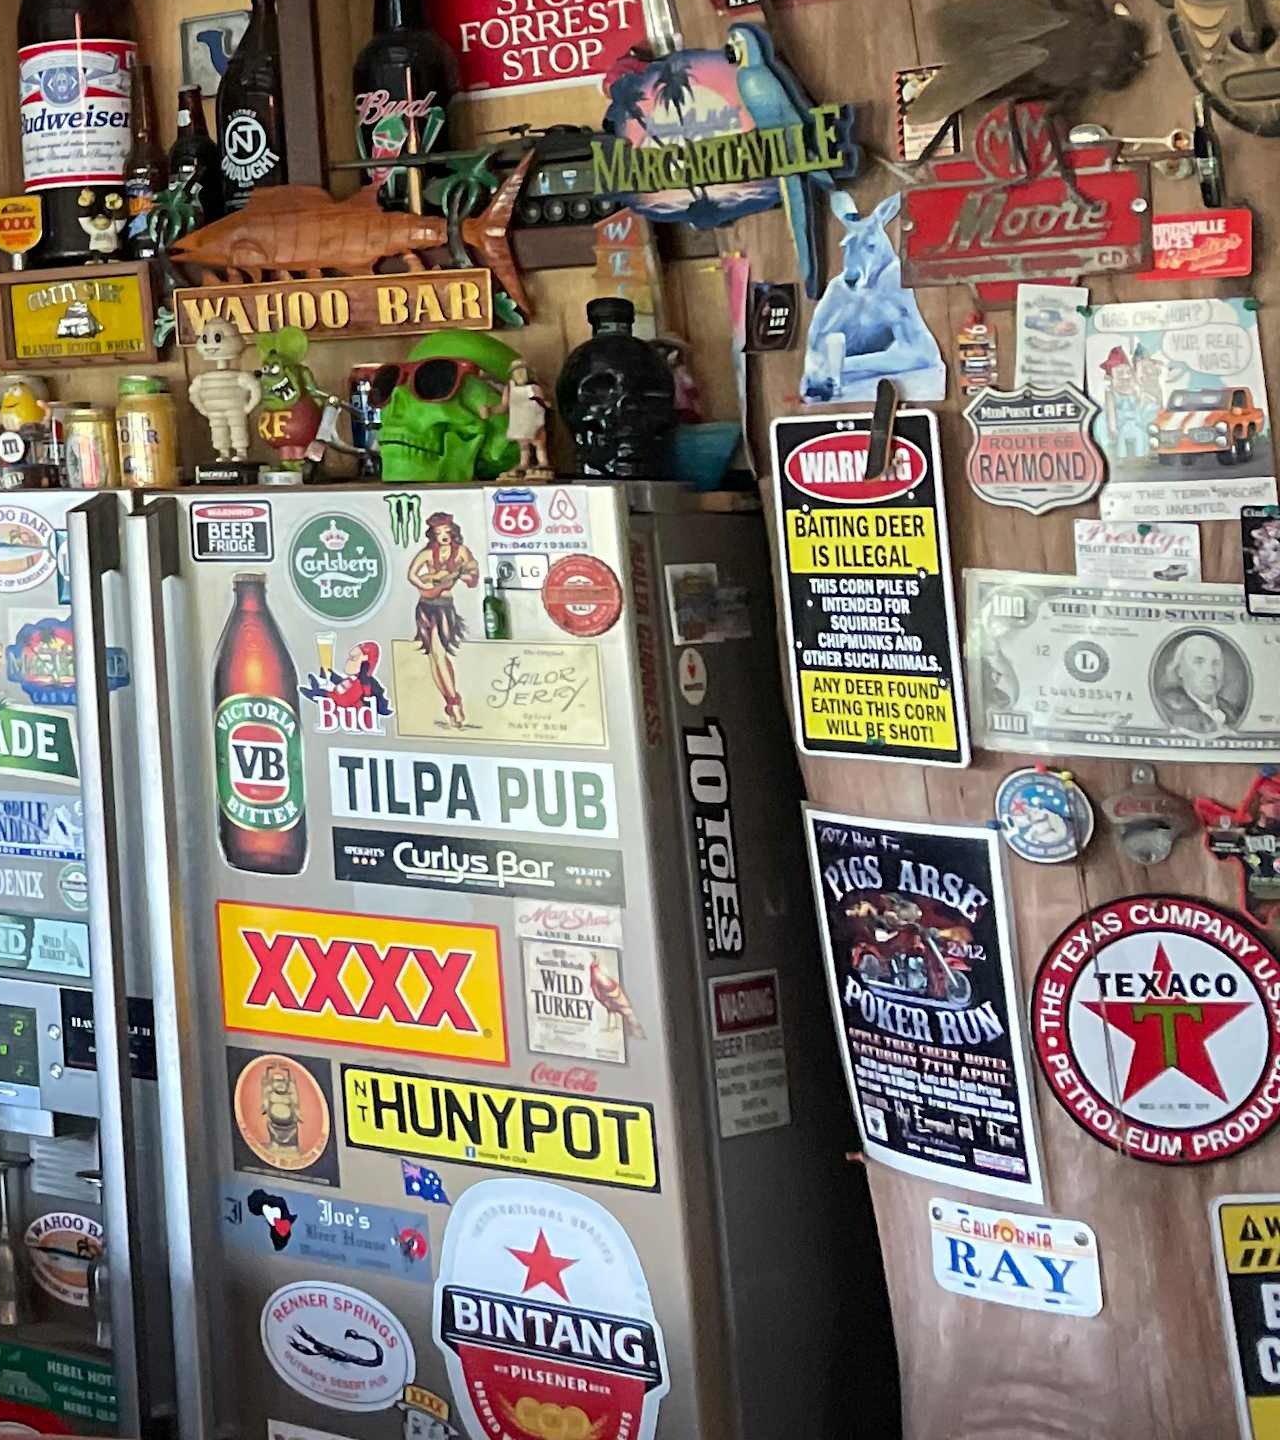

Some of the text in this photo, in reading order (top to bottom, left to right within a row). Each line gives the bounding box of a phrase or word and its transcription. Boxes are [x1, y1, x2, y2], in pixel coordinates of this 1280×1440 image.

[502, 39, 603, 82] STOP
[356, 90, 436, 123] Bud
[591, 103, 843, 194] MARGARITAVILLE
[935, 187, 1110, 252] Moore
[182, 281, 484, 340] WAHOO BAR
[23, 339, 143, 356] BLENDED SCOTCH WHISKY
[799, 447, 911, 483] WARNG
[979, 452, 1087, 484] RAYMOND
[207, 522, 255, 542] BEER
[795, 516, 925, 538] BAITING DEER
[208, 539, 256, 553] FRIDGE
[295, 547, 378, 583] Carlsberg
[520, 566, 541, 579] LG
[318, 580, 362, 599] Beer
[809, 579, 919, 595] THIS CORN PILE IS
[831, 616, 905, 634] SQUIRRELS,
[1049, 603, 1233, 622] THE UNITED STATES
[813, 678, 939, 699] ANY DEER FOUND
[315, 696, 380, 734] Bud
[826, 720, 934, 743] WILL BE SHOT!
[338, 755, 608, 830] TILPA PUB
[686, 726, 742, 955] 10 TOES
[242, 930, 479, 1034] XXXX
[540, 969, 584, 996] WILD
[1097, 973, 1237, 998] TEXACO
[531, 988, 594, 1021] TURKEY
[845, 977, 1006, 1046] POKER RUN
[853, 1042, 1009, 1086] SATURDAY 7TH APRIL
[371, 1079, 641, 1166] HUNYPOT
[319, 1199, 372, 1230] Joe's
[960, 1217, 1052, 1249] CALIFORNIA
[946, 1236, 1078, 1295] RAY
[272, 1294, 399, 1351] RENNER SPRINGS
[452, 1293, 644, 1367] BINTANG
[330, 1377, 366, 1391] DESERT
[368, 1374, 389, 1391] PUB
